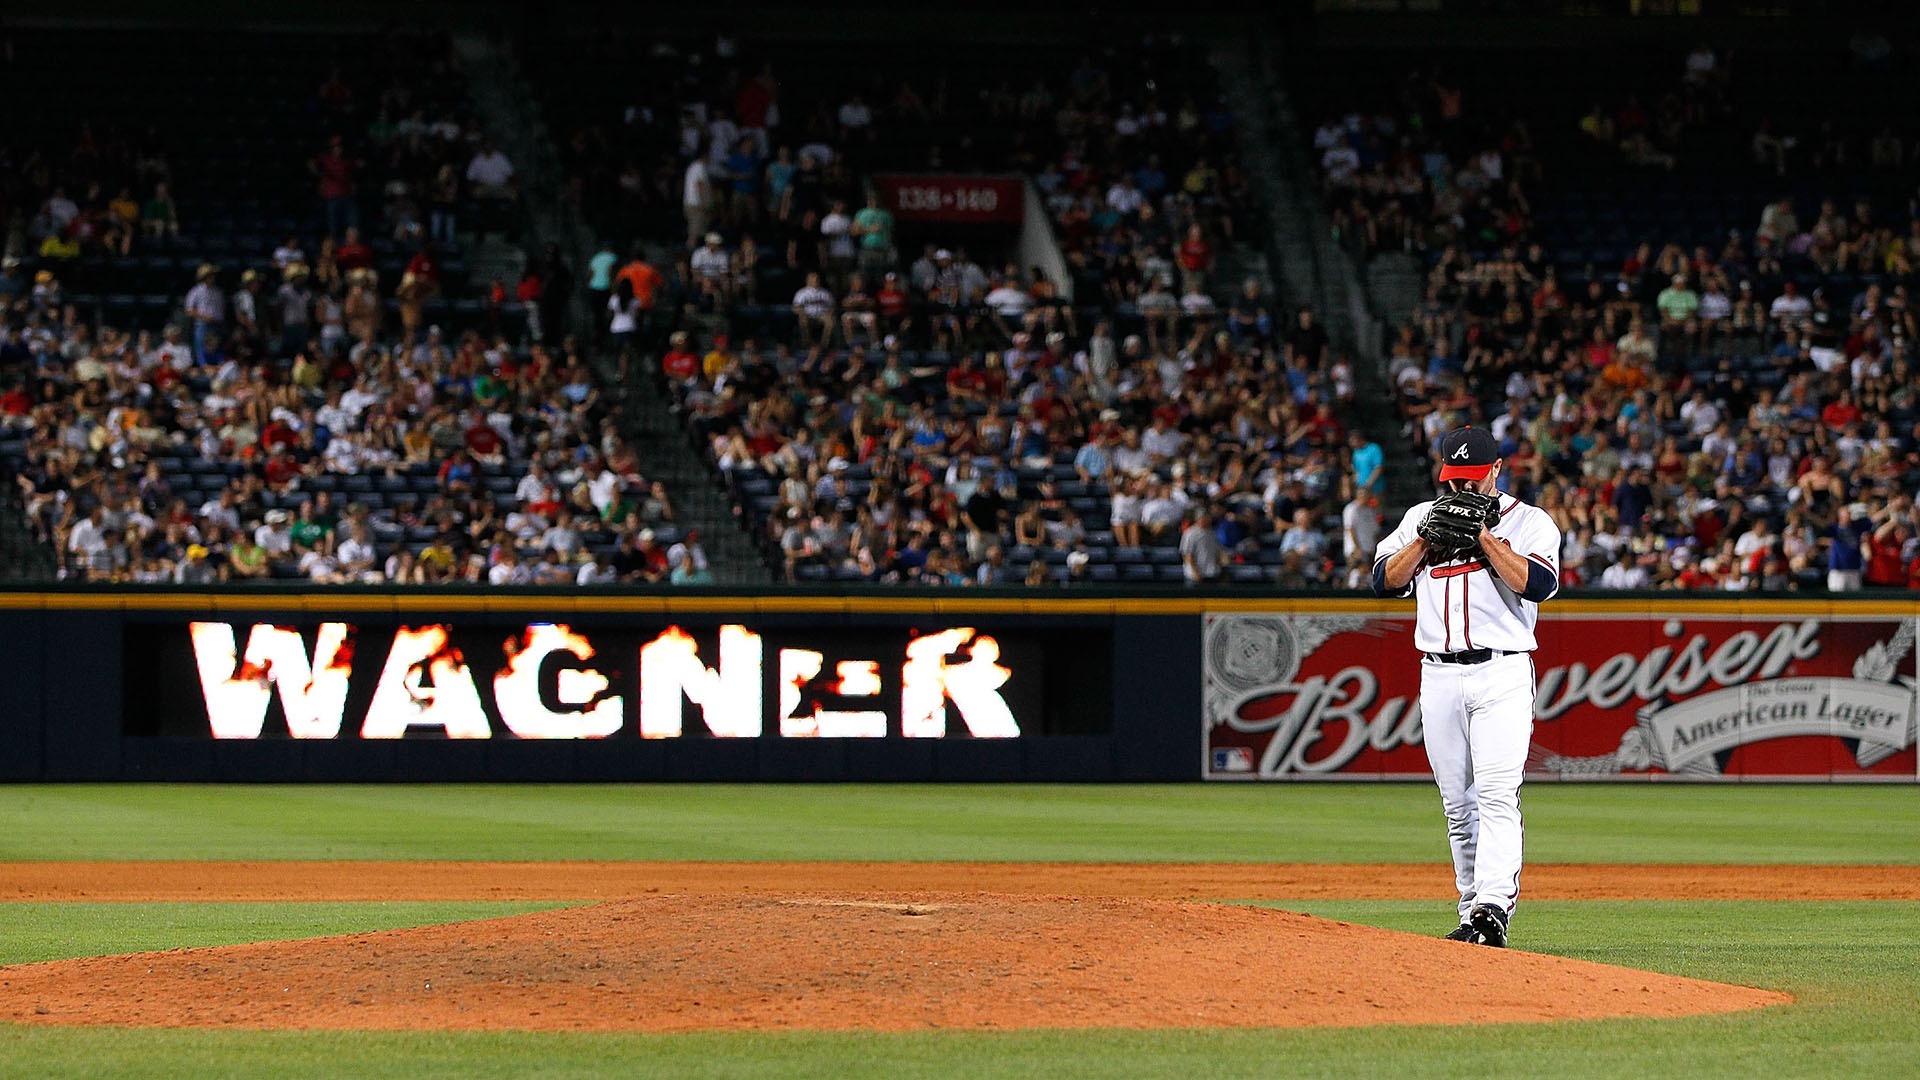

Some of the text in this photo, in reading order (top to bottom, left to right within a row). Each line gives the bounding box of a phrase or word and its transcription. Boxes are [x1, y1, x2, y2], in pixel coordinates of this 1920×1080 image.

[1451, 442, 1469, 459] A
[1448, 505, 1470, 517] TPX
[190, 622, 1020, 739] WAGNER
[1226, 619, 1821, 779] Buweiser
[1671, 694, 1903, 751] American Lager
